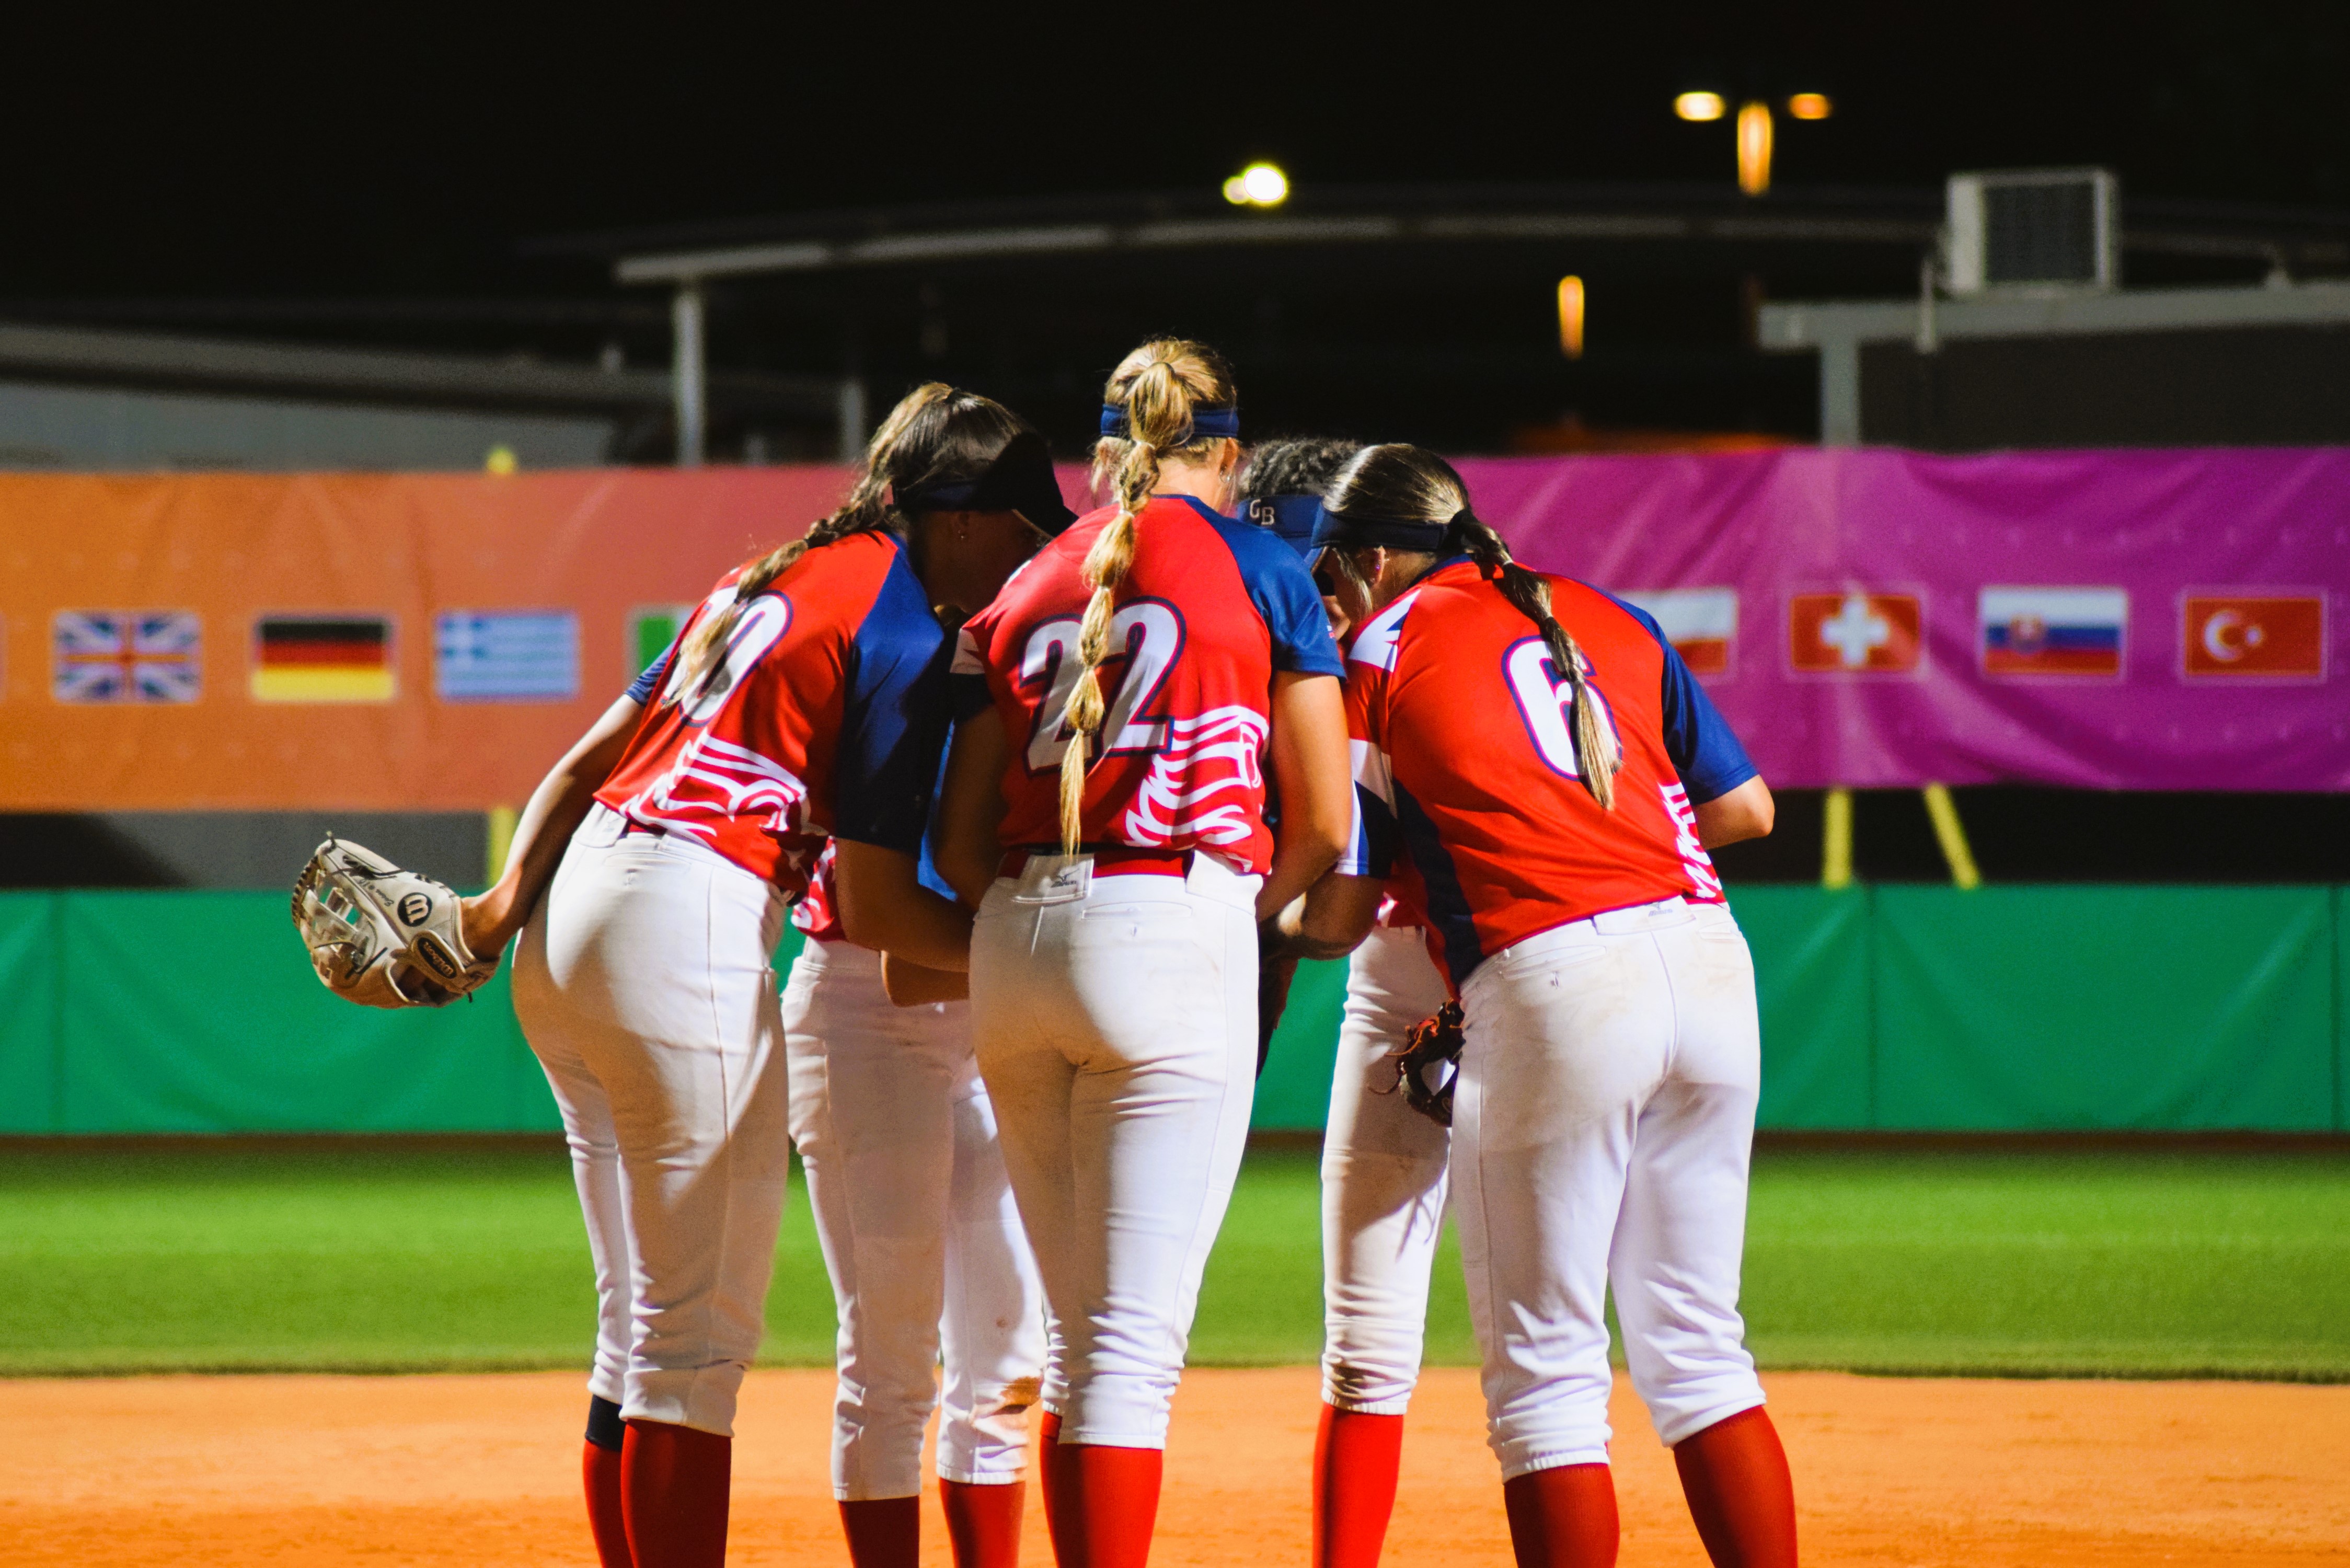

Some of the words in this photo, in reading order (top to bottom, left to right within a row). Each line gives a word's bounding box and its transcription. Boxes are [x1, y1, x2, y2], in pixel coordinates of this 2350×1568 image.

[1249, 499, 1275, 526] GB
[1018, 595, 1186, 778] 22
[1500, 633, 1623, 782] 6
